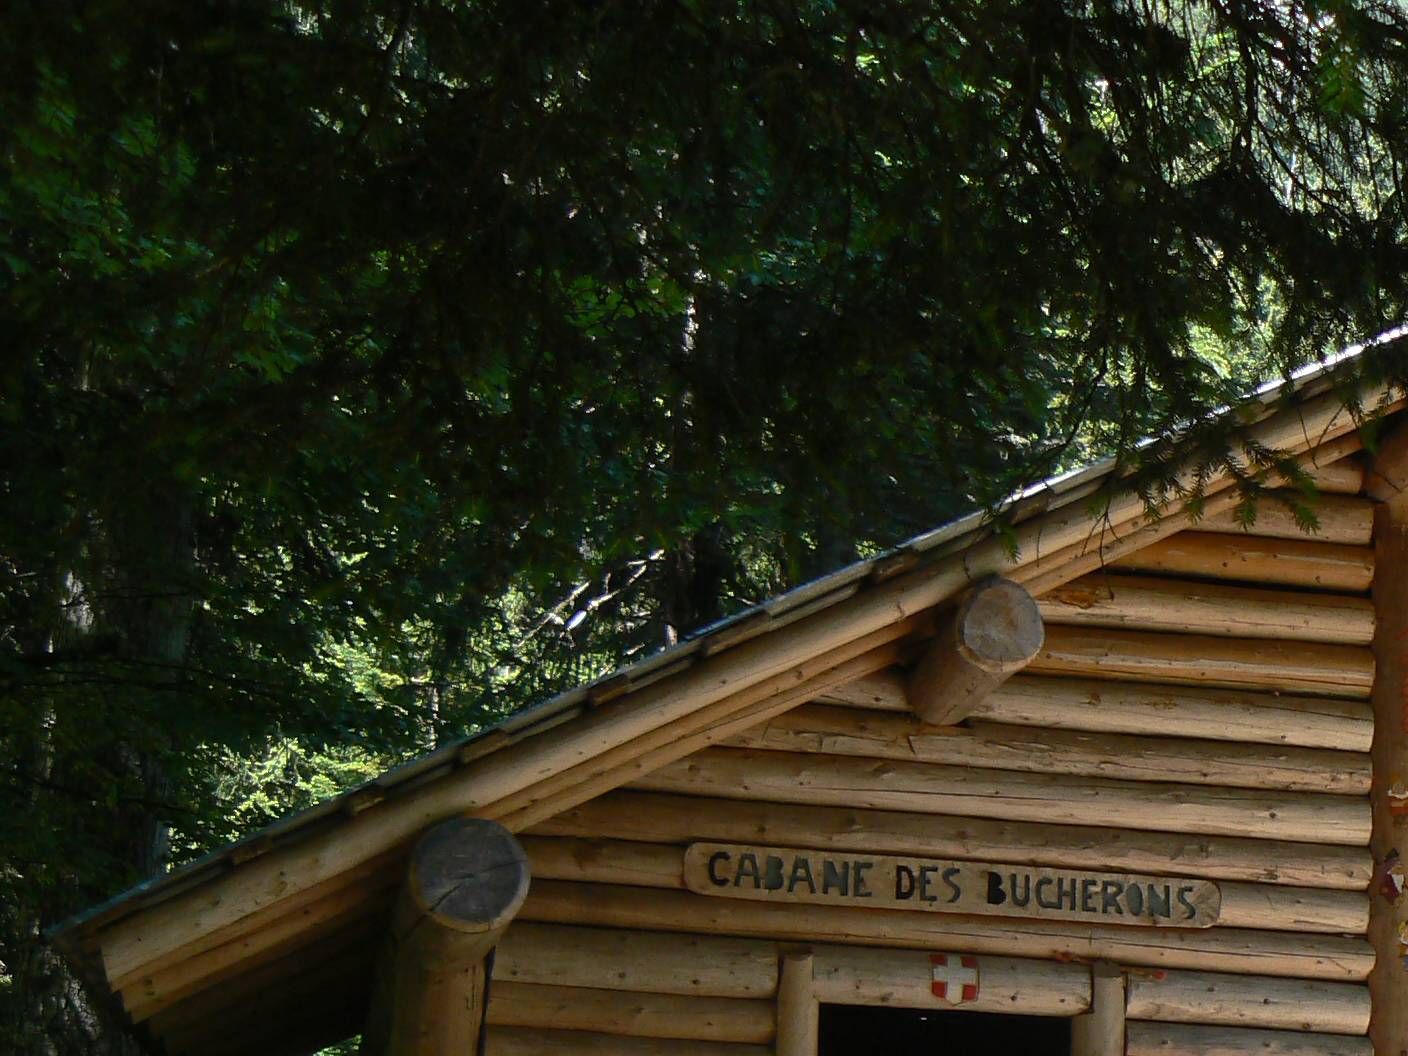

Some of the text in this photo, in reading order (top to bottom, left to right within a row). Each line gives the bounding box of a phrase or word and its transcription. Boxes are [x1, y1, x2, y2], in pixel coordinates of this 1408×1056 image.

[707, 851, 1197, 921] CABANE DES BUCHERONS
